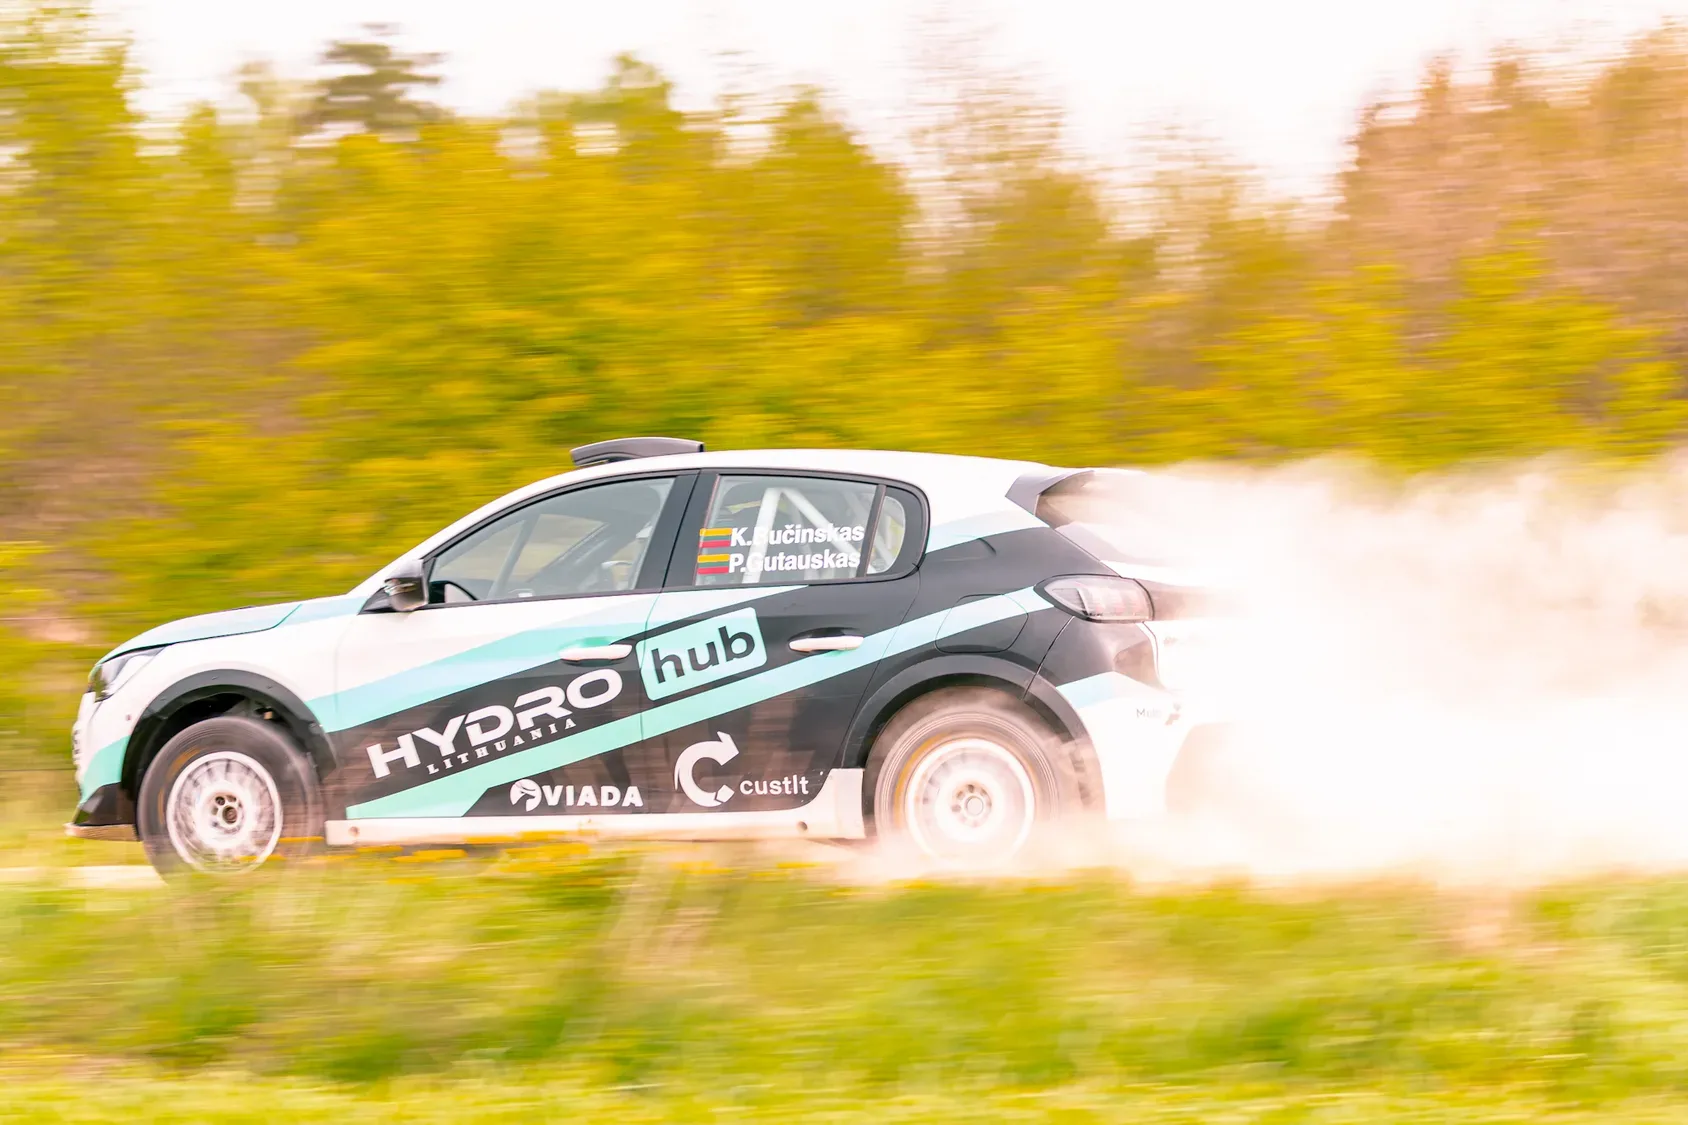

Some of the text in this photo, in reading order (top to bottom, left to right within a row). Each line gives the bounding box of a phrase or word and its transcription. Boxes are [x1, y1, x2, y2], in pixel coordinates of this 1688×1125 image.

[728, 550, 861, 573] P.Gutauskas
[366, 625, 756, 779] HYDRO hub
[425, 718, 577, 775] LITHUANIA
[541, 785, 644, 807] VIADA
